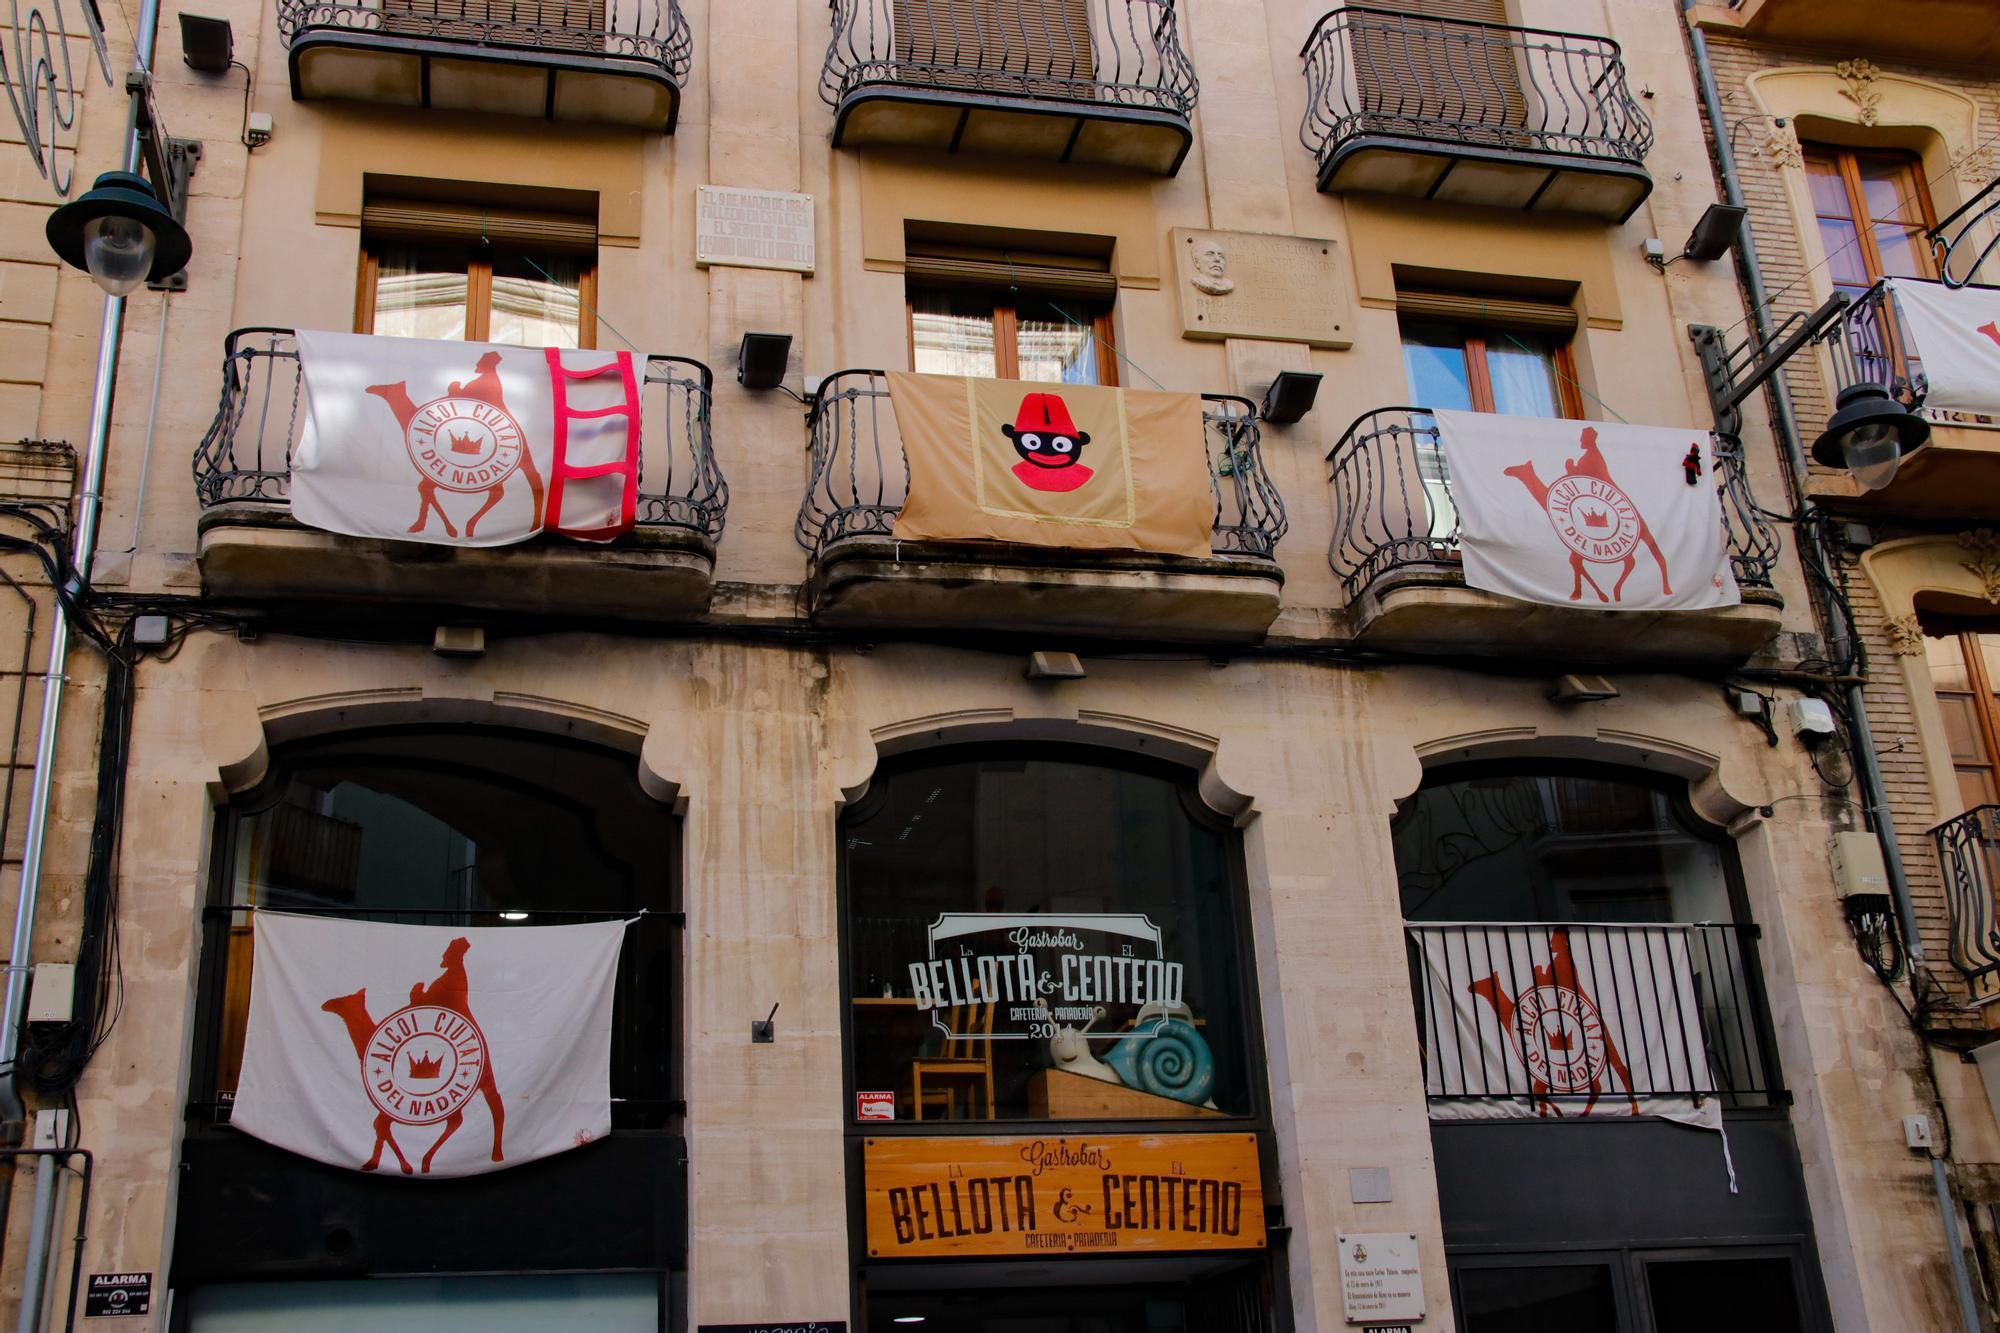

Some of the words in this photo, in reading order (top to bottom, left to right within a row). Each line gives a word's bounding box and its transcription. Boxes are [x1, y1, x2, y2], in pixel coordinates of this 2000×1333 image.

[414, 402, 457, 436] ALCOI
[473, 404, 519, 451] CIUTAT
[421, 450, 447, 477] DEL
[452, 460, 510, 485] NADAL
[1552, 480, 1581, 513] ALCOI
[1591, 481, 1635, 522] CIUTAT
[1565, 526, 1588, 550] DEL
[1593, 532, 1634, 556] NADAL
[1009, 927, 1084, 954] Gastrobar
[1122, 945, 1135, 957] EL
[909, 954, 1037, 1011] BELLOTA
[1037, 971, 1063, 994] &
[1061, 954, 1184, 1009] CENTENO
[371, 1013, 418, 1063] ALCOI
[434, 1012, 480, 1066] CIUTAT
[1527, 1051, 1550, 1077] DE
[1557, 1055, 1599, 1083] NADAL
[377, 1080, 405, 1110] DEL
[409, 1083, 470, 1116] NADAL
[948, 1164, 963, 1179] LA
[1171, 1161, 1186, 1175] EL
[1020, 1141, 1110, 1176] Gastrobar
[888, 1174, 1037, 1244] BELLOTA
[1053, 1188, 1092, 1223] &
[1102, 1174, 1241, 1237] CENTENO
[1025, 1233, 1067, 1248] CAFETERIA
[1073, 1232, 1118, 1247] PANADERIA
[94, 1274, 147, 1285] ALARMA
